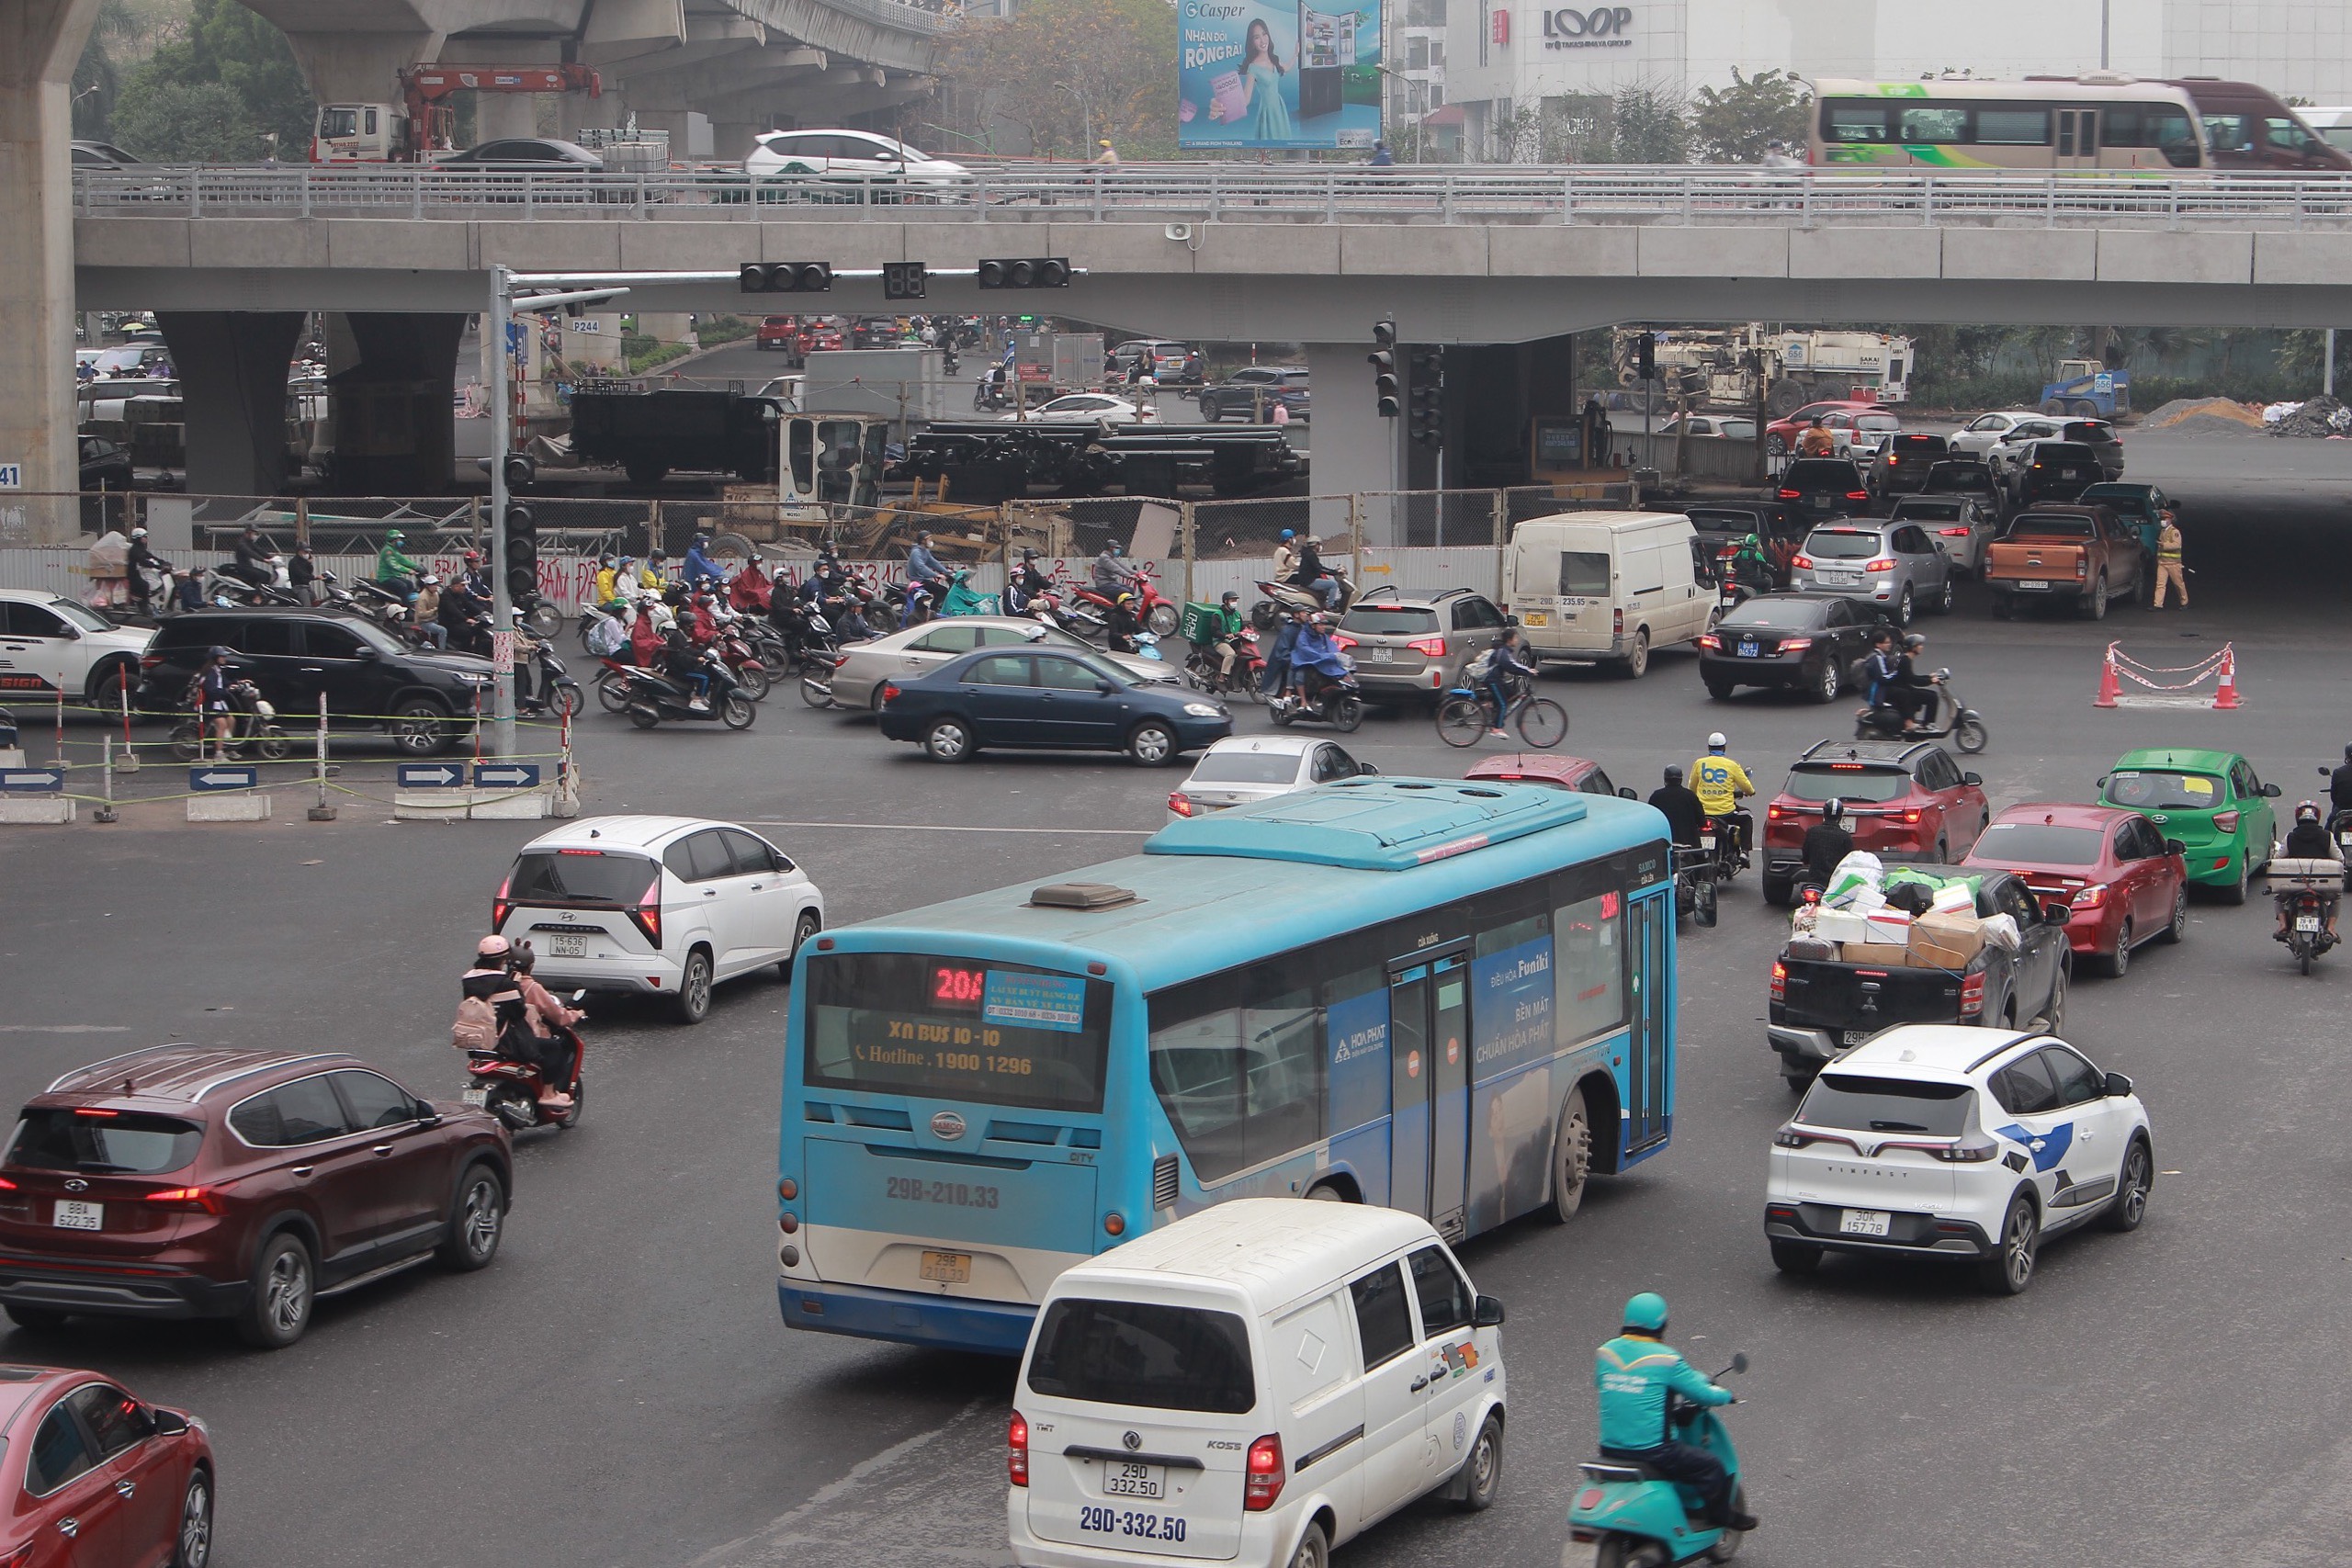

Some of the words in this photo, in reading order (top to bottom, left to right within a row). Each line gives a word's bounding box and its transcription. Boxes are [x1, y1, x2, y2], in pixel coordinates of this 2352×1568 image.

[1200, 4, 1245, 20] Casper
[1544, 7, 1632, 37] LOOP
[1185, 28, 1212, 42] NHÂN
[1562, 40, 1607, 49] TAKASHIMAYA
[1185, 43, 1225, 70] RỘNG
[574, 322, 597, 332] P244
[1788, 350, 1803, 358] 656
[1702, 762, 1728, 784] be
[555, 937, 582, 946] 15-636
[555, 946, 580, 954] NN-05
[1518, 952, 1549, 978] Funiki
[1533, 997, 1549, 1016] MÁT
[918, 1023, 949, 1043] BUS
[1476, 1032, 1508, 1064] CHUẨN
[1508, 1029, 1527, 1052] HÒA
[1528, 1020, 1549, 1044] PHÁT
[870, 1045, 924, 1066] Hotline
[935, 1052, 979, 1072] 1900
[986, 1055, 1032, 1076] 1296
[931, 1120, 964, 1133] SAMCO
[1069, 1152, 1094, 1164] CITY
[1827, 1166, 1908, 1178] VINFAST
[887, 1176, 1000, 1210] 29B-210.33
[68, 1202, 88, 1214] 88A
[58, 1214, 96, 1229] 622.35
[1856, 1211, 1877, 1222] 30K
[1847, 1222, 1883, 1235] 157.78
[935, 1254, 957, 1267] 29B
[924, 1266, 964, 1281] 210.33
[1206, 1440, 1242, 1450] KOSS
[1121, 1463, 1148, 1479] 29D
[1110, 1478, 1158, 1495] 332.50
[1080, 1506, 1187, 1543] 29D-332.50
